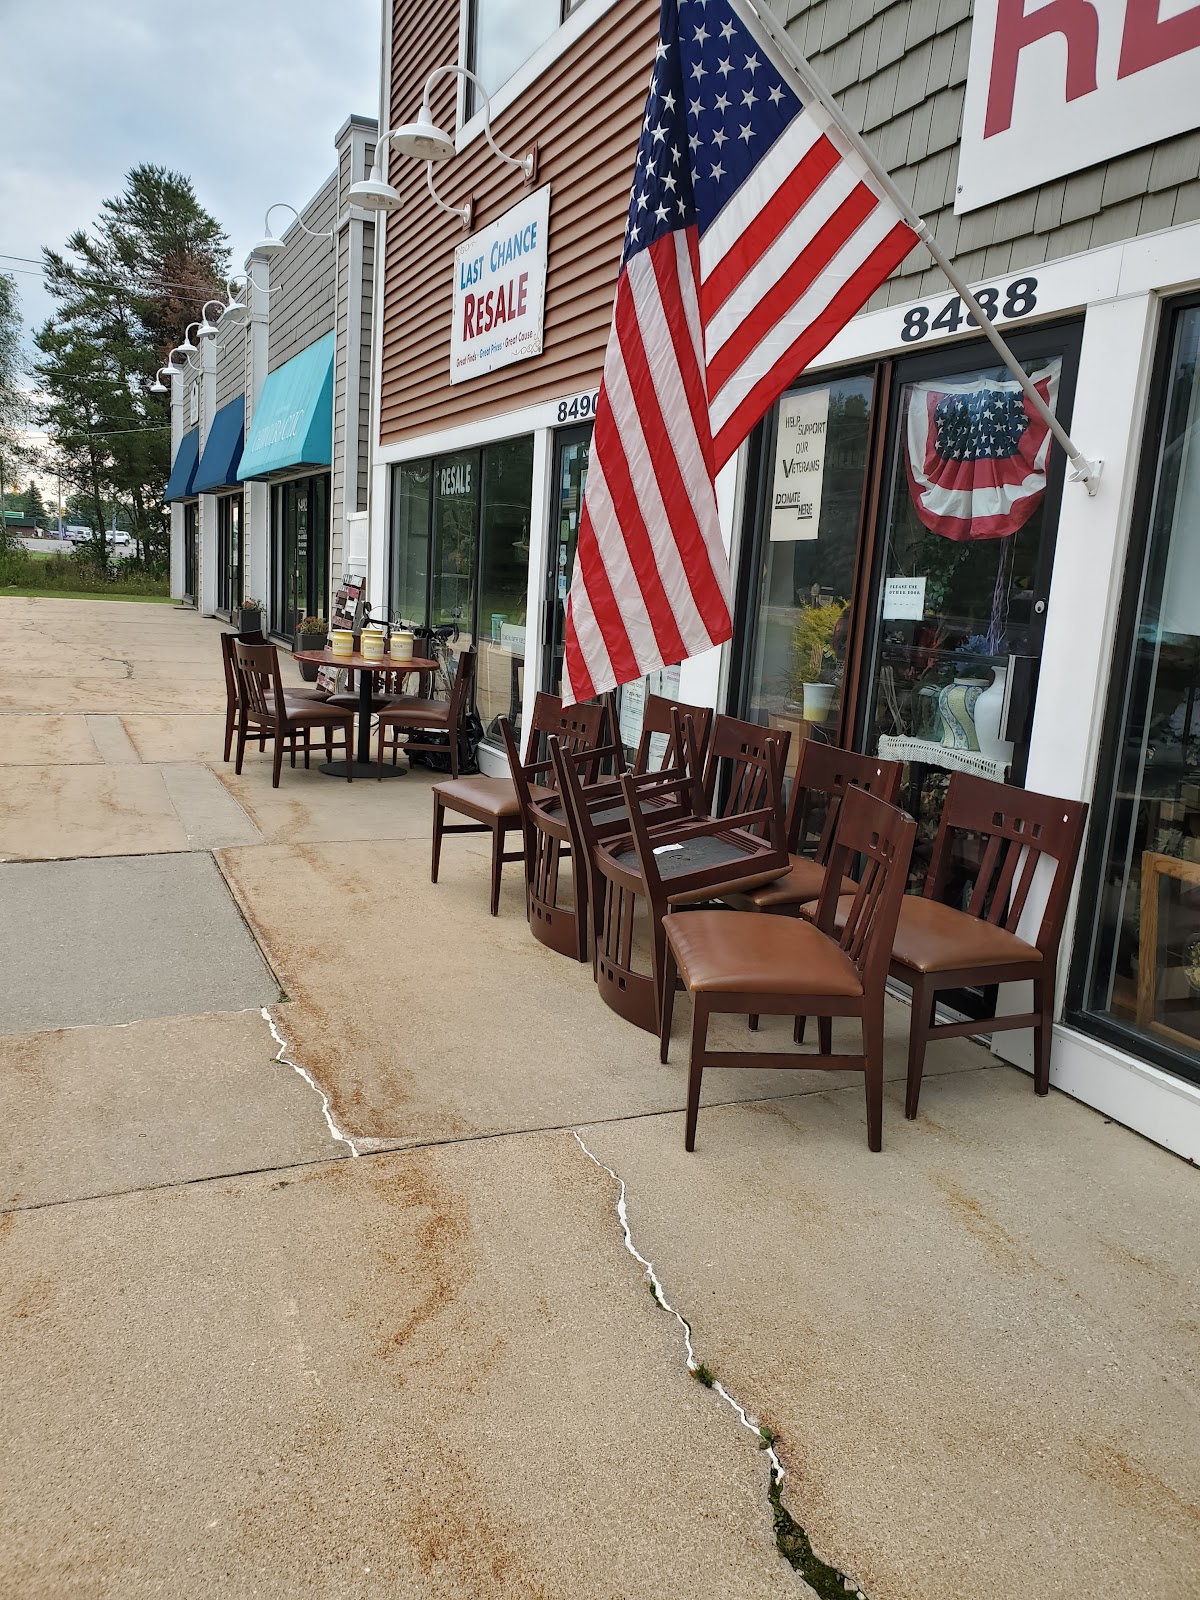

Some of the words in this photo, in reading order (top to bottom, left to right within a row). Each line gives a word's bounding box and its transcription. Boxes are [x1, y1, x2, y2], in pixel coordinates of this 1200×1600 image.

[460, 255, 484, 290] LAST
[490, 221, 538, 273] CHANCE
[462, 271, 529, 342] RESALE
[900, 277, 1038, 342] 8488
[456, 356, 466, 367] Great
[467, 351, 477, 364] Finds
[480, 347, 490, 358] Great
[491, 341, 502, 354] Prices
[505, 334, 518, 347] Great
[518, 330, 533, 342] Cause
[785, 415, 801, 428] HELP
[798, 421, 826, 435] SUPPORT
[795, 441, 809, 454] OUR
[440, 464, 471, 495] RESALE
[782, 458, 820, 478] VETERANS
[775, 491, 801, 505] DONATE
[797, 503, 813, 516] HERE
